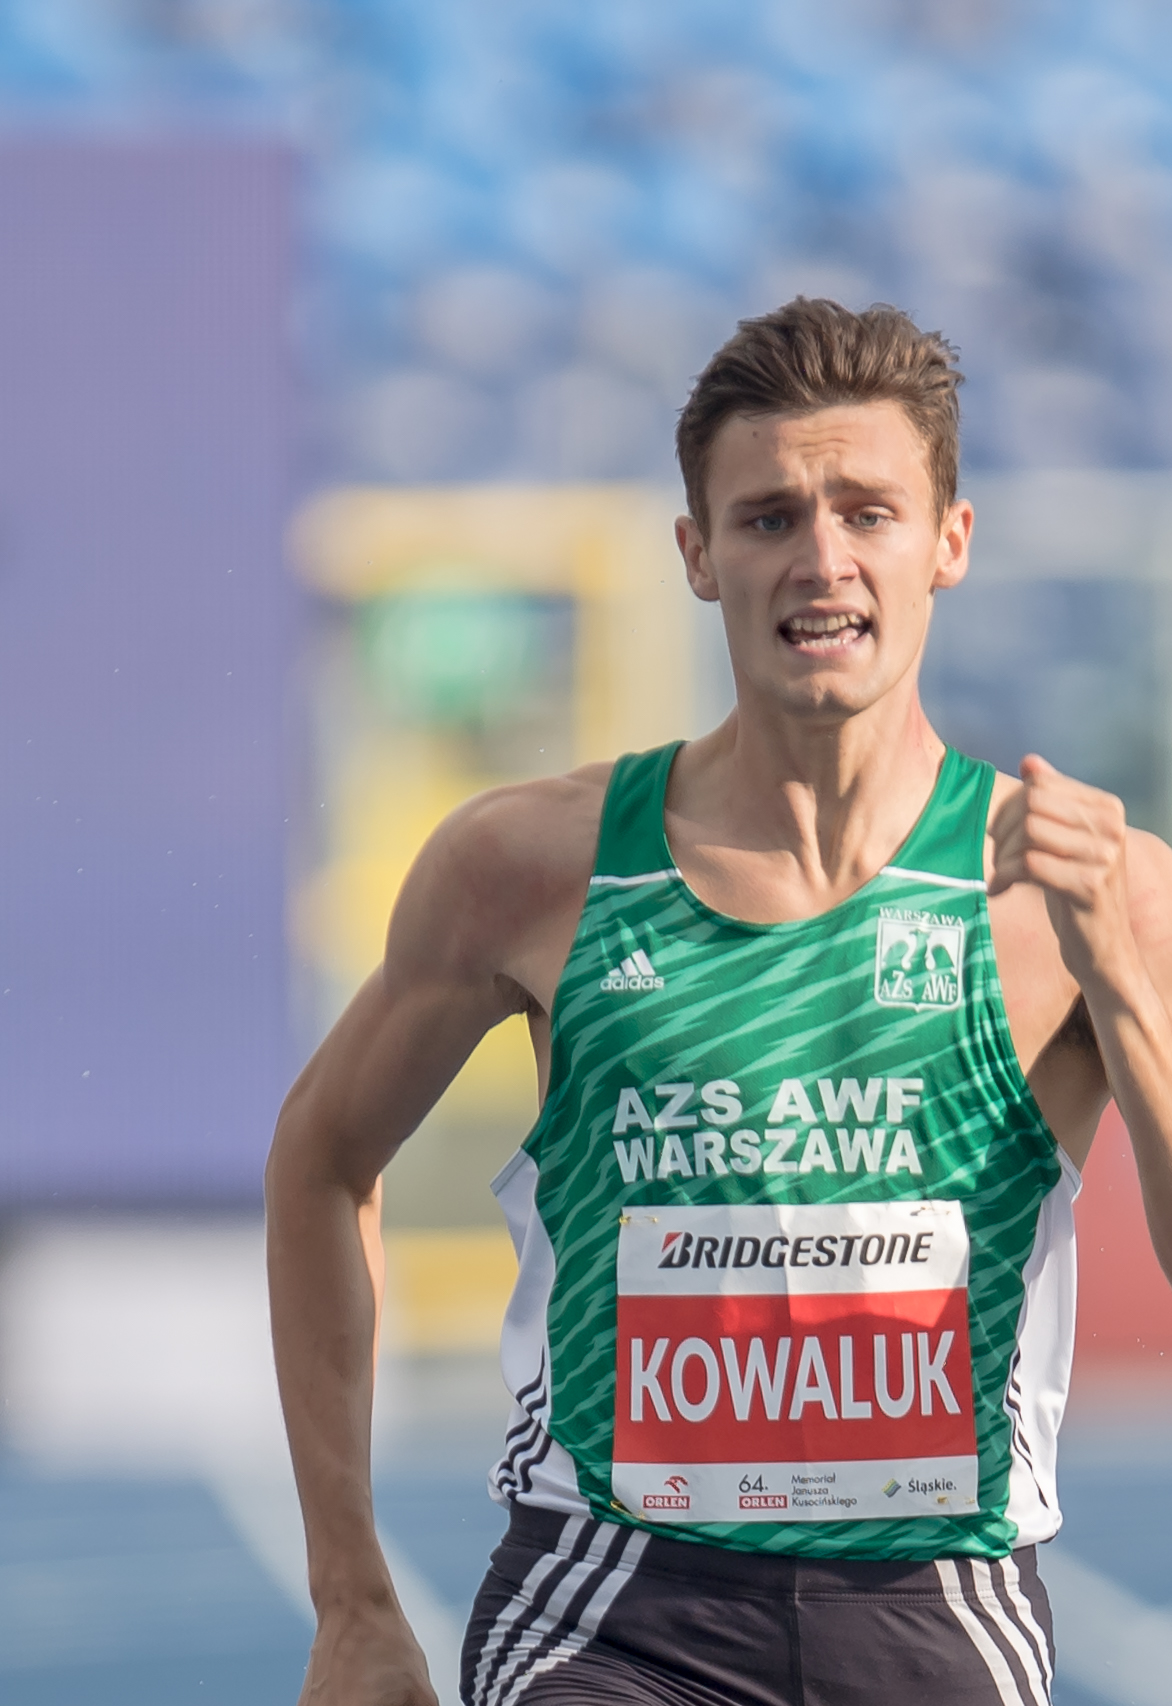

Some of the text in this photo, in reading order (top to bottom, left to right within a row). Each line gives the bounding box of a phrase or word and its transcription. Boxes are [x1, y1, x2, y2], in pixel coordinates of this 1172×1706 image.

[880, 907, 963, 926] WARSZAWA
[600, 974, 664, 991] adidas
[880, 970, 957, 1002] AZS AWF
[612, 1077, 924, 1134] AZS AWF
[613, 1128, 922, 1184] WARSZAWA
[658, 1231, 934, 1269] BRIDGESTONE
[630, 1330, 962, 1422] KOWALUK
[738, 1474, 769, 1493] 64.
[791, 1486, 829, 1496] Janusza
[645, 1496, 687, 1507] ORLEN
[741, 1496, 785, 1507] ORLEN
